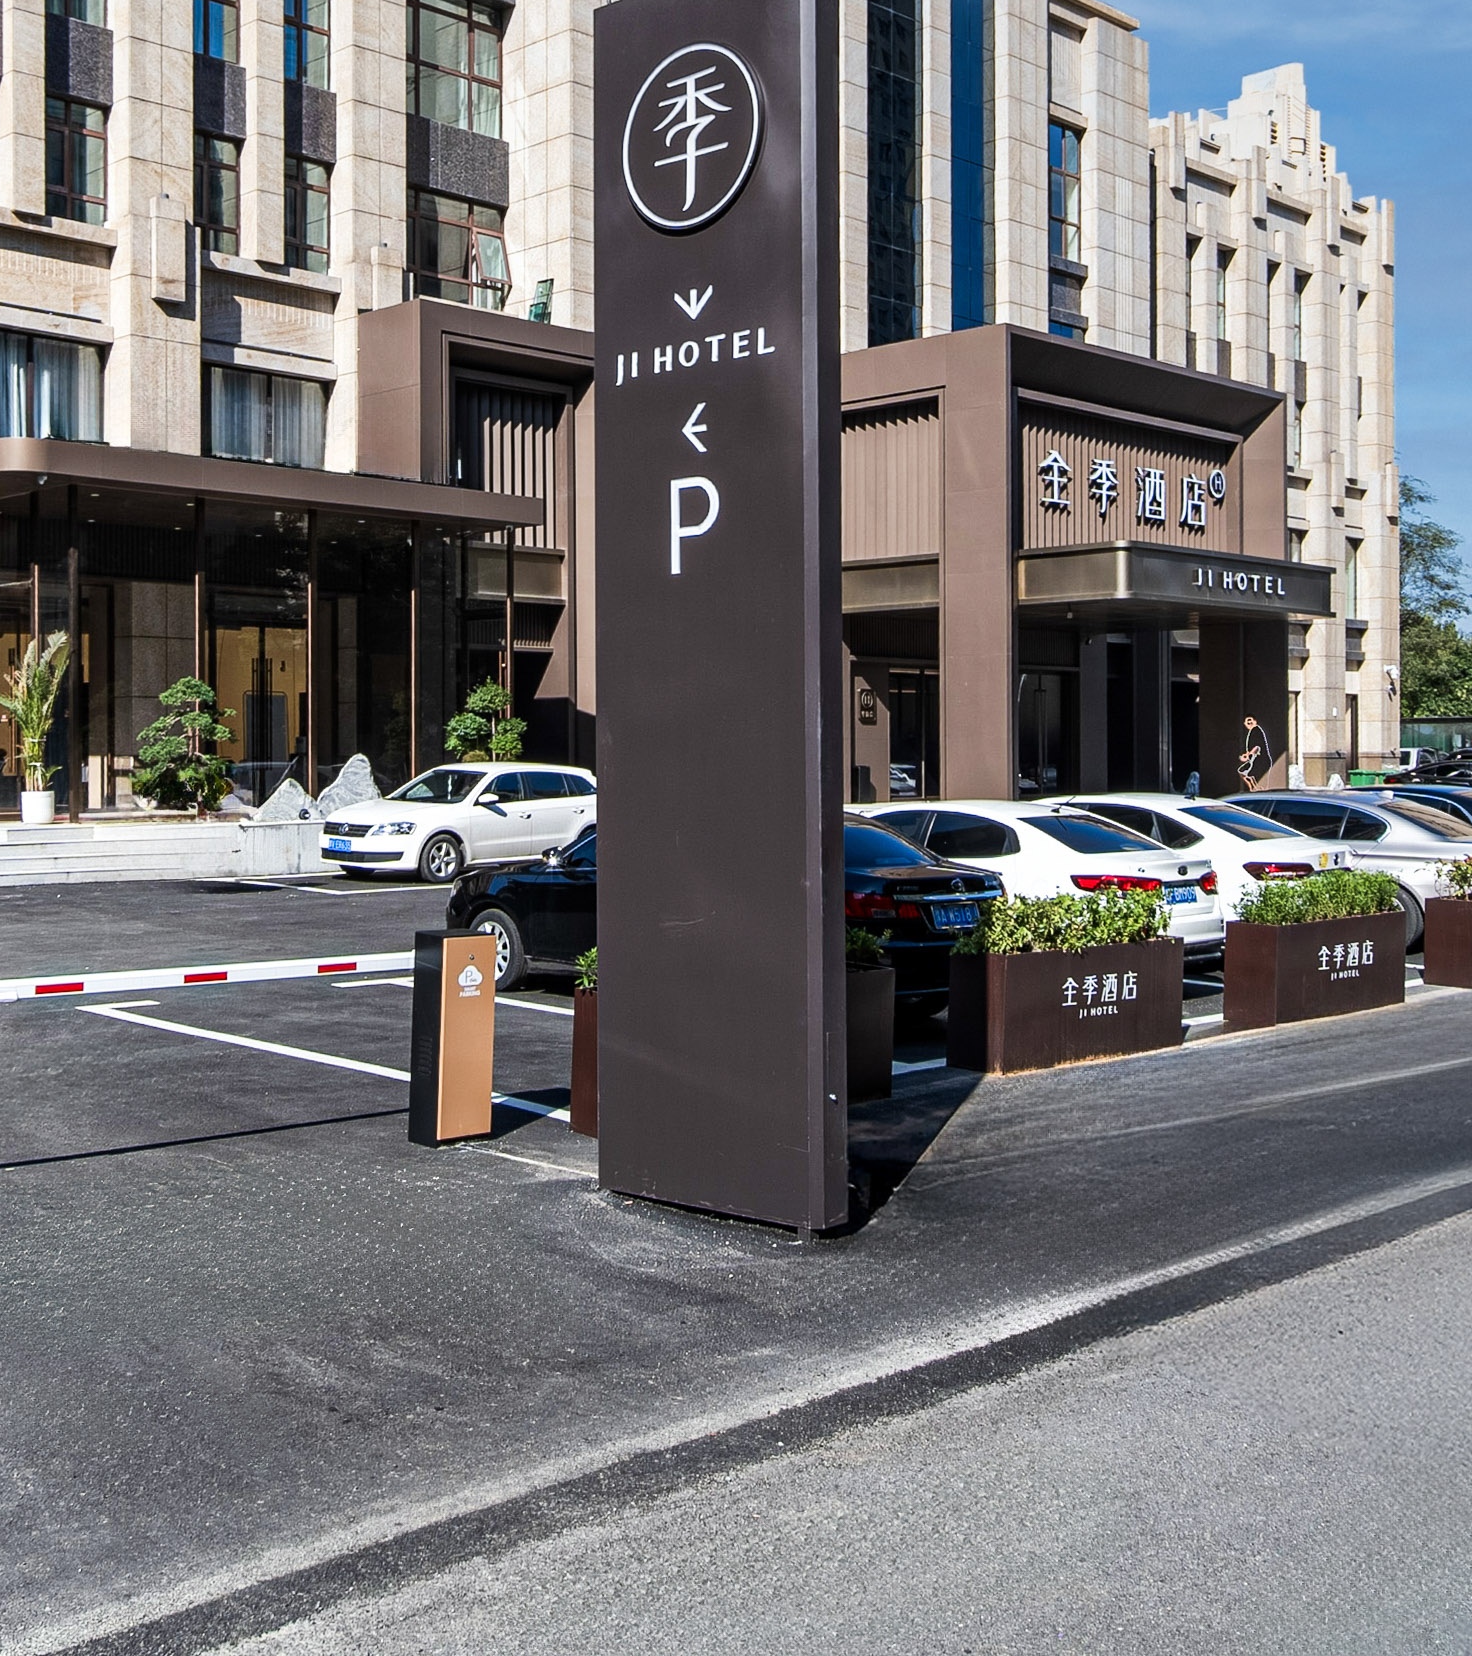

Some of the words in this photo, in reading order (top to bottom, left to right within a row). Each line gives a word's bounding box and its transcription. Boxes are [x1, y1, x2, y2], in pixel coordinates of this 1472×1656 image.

[615, 351, 639, 387] JI
[653, 326, 776, 374] HOTEL
[1038, 449, 1208, 528] 全季酒店
[670, 475, 721, 576] P
[1191, 567, 1214, 587] JI
[1222, 570, 1286, 596] HOTEL
[1317, 939, 1375, 971] 全季酒店
[1061, 970, 1138, 1007] 全季酒店
[1339, 969, 1360, 979] HOTEL
[1079, 1008, 1087, 1019] JI
[1090, 1005, 1119, 1017] HOTEL
